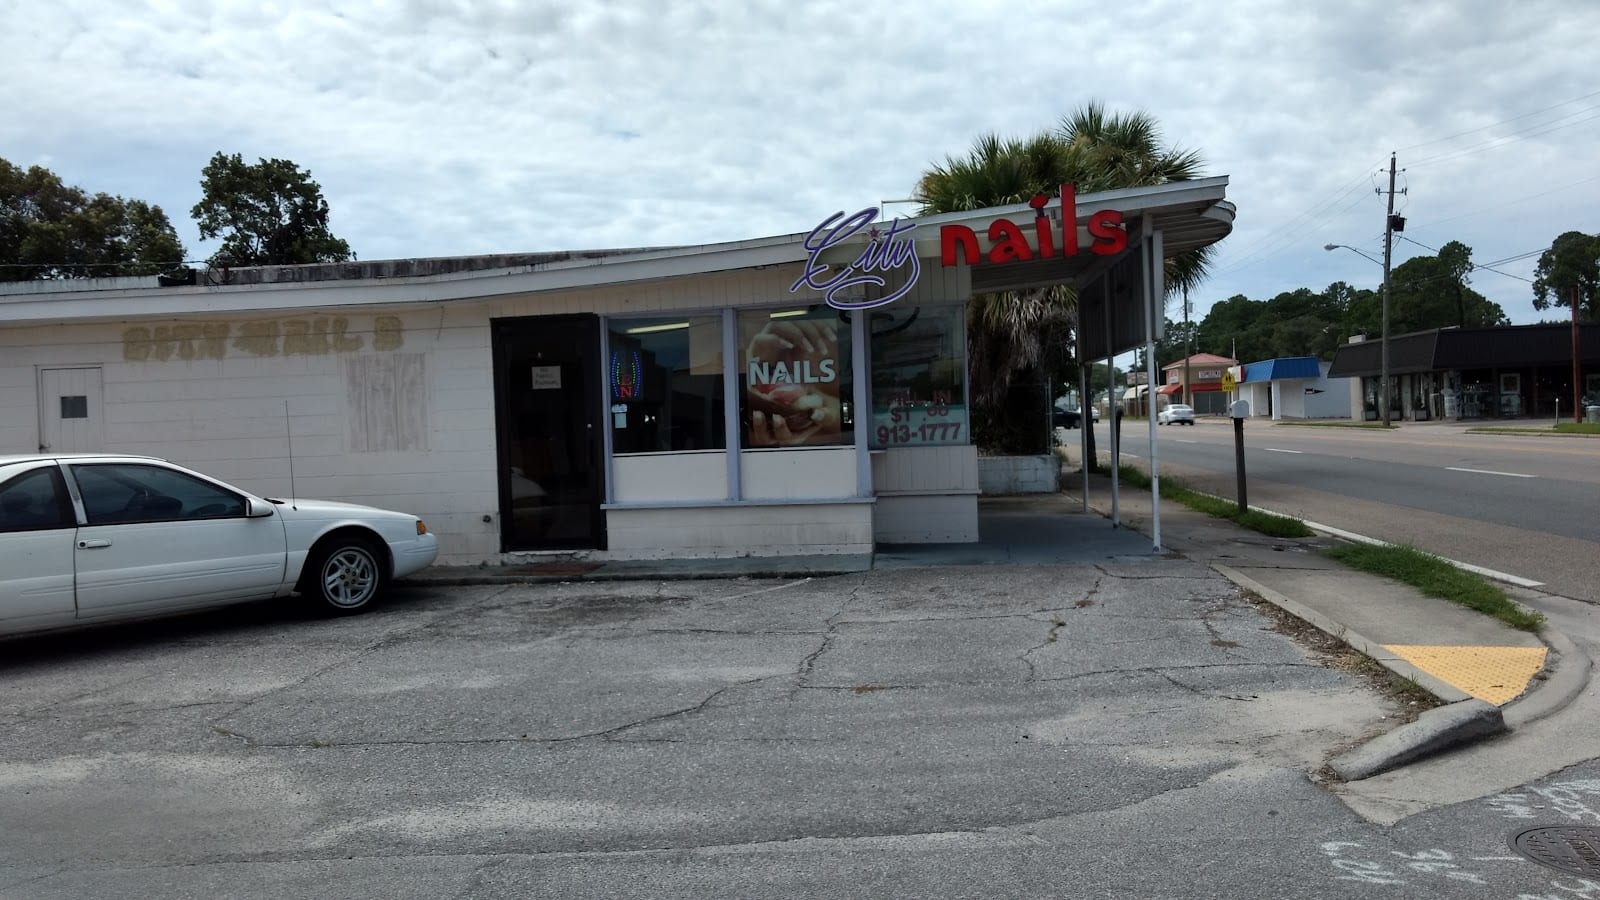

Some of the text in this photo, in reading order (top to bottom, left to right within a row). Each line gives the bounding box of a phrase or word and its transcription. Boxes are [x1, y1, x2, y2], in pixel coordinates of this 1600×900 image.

[790, 183, 1129, 310] City nails
[749, 358, 837, 385] NAILS
[877, 422, 961, 444] 913-1777
